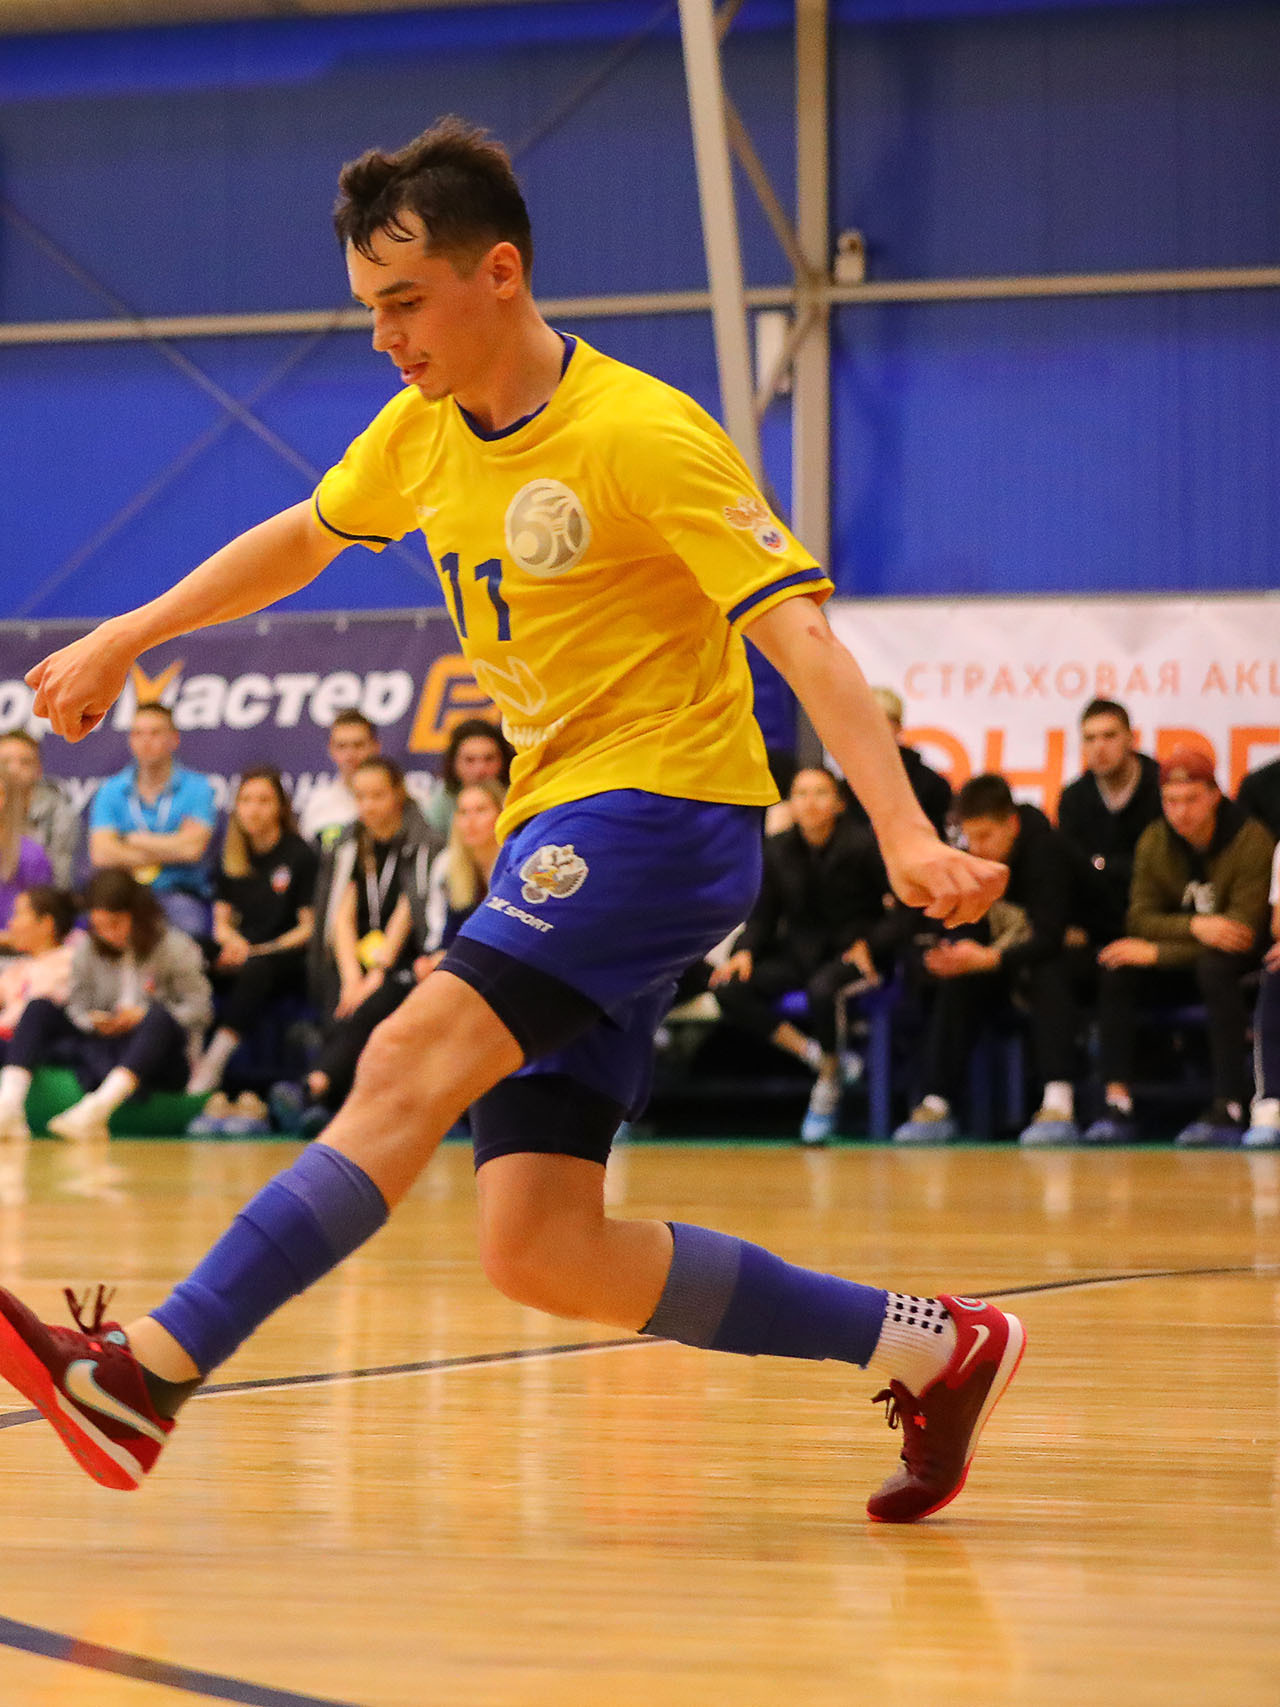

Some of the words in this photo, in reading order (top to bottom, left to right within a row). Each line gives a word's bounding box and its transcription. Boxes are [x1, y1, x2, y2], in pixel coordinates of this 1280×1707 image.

[439, 552, 512, 641] 11
[903, 661, 1181, 699] СТРАХОВАЯ
[504, 906, 554, 933] SPORT
